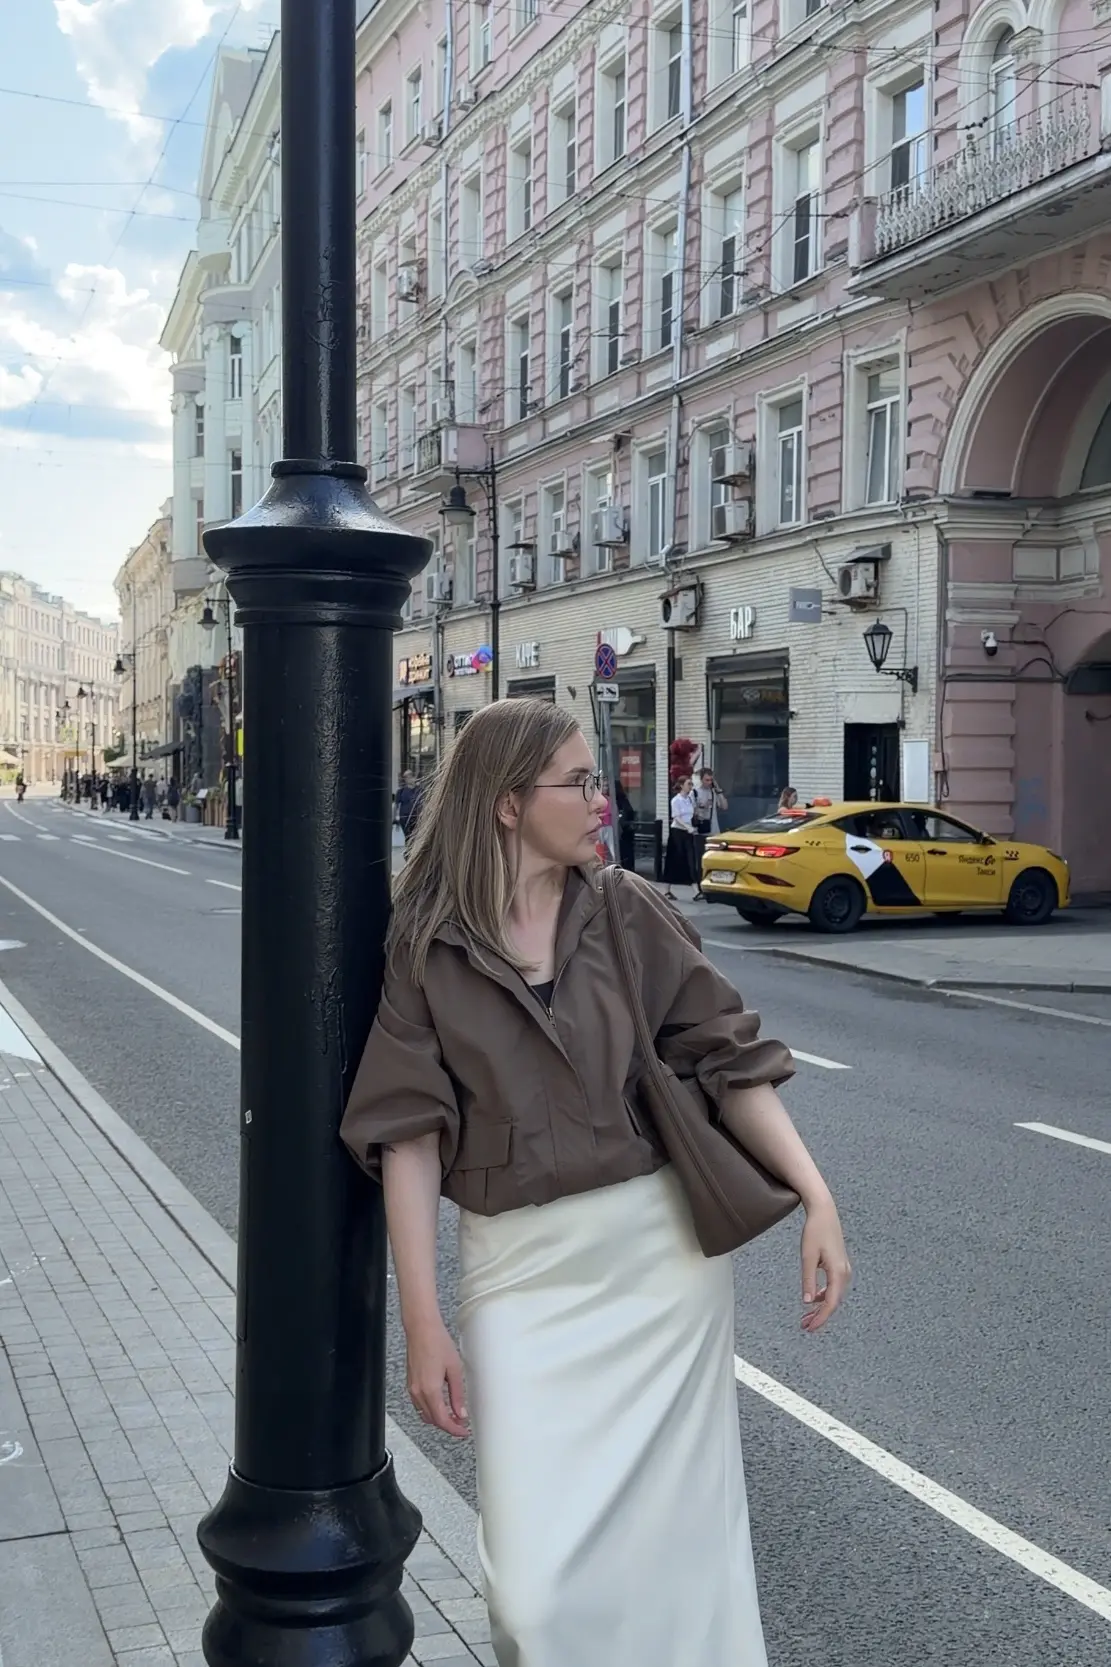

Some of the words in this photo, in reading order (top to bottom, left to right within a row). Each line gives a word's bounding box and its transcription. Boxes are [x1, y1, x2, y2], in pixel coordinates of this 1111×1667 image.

[730, 605, 754, 639] БАР
[905, 853, 920, 862] 650
[958, 855, 984, 864] Яндекс
[977, 867, 996, 876] Такси
